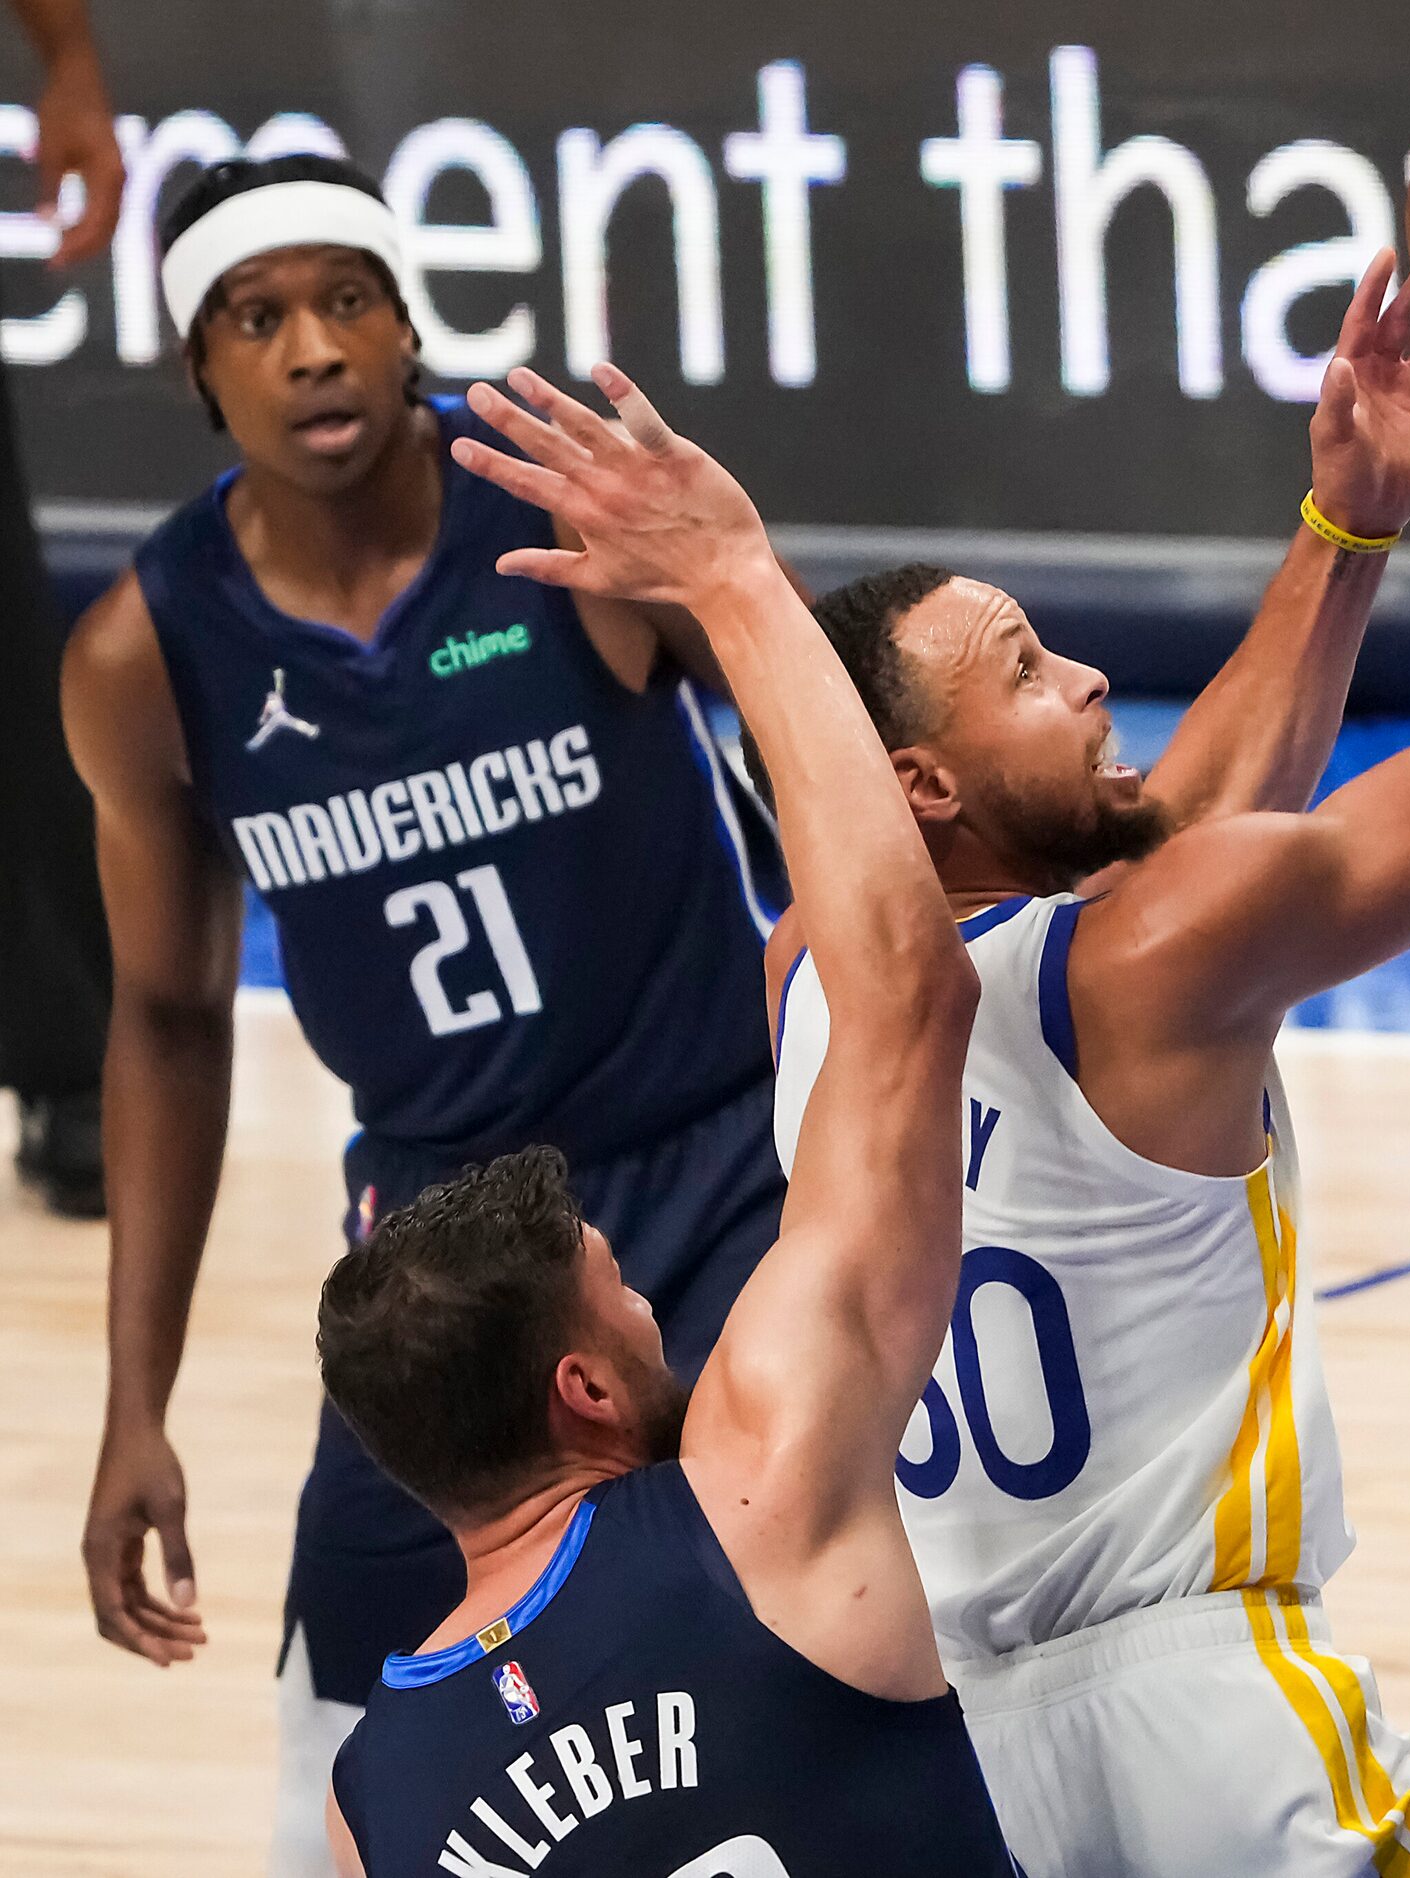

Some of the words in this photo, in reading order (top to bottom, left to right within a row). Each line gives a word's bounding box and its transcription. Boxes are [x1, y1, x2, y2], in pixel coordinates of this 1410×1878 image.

[429, 622, 529, 679] chime
[233, 724, 602, 891] MAVERICKS
[384, 864, 543, 1037] 21
[437, 1691, 699, 1878] KLEBER
